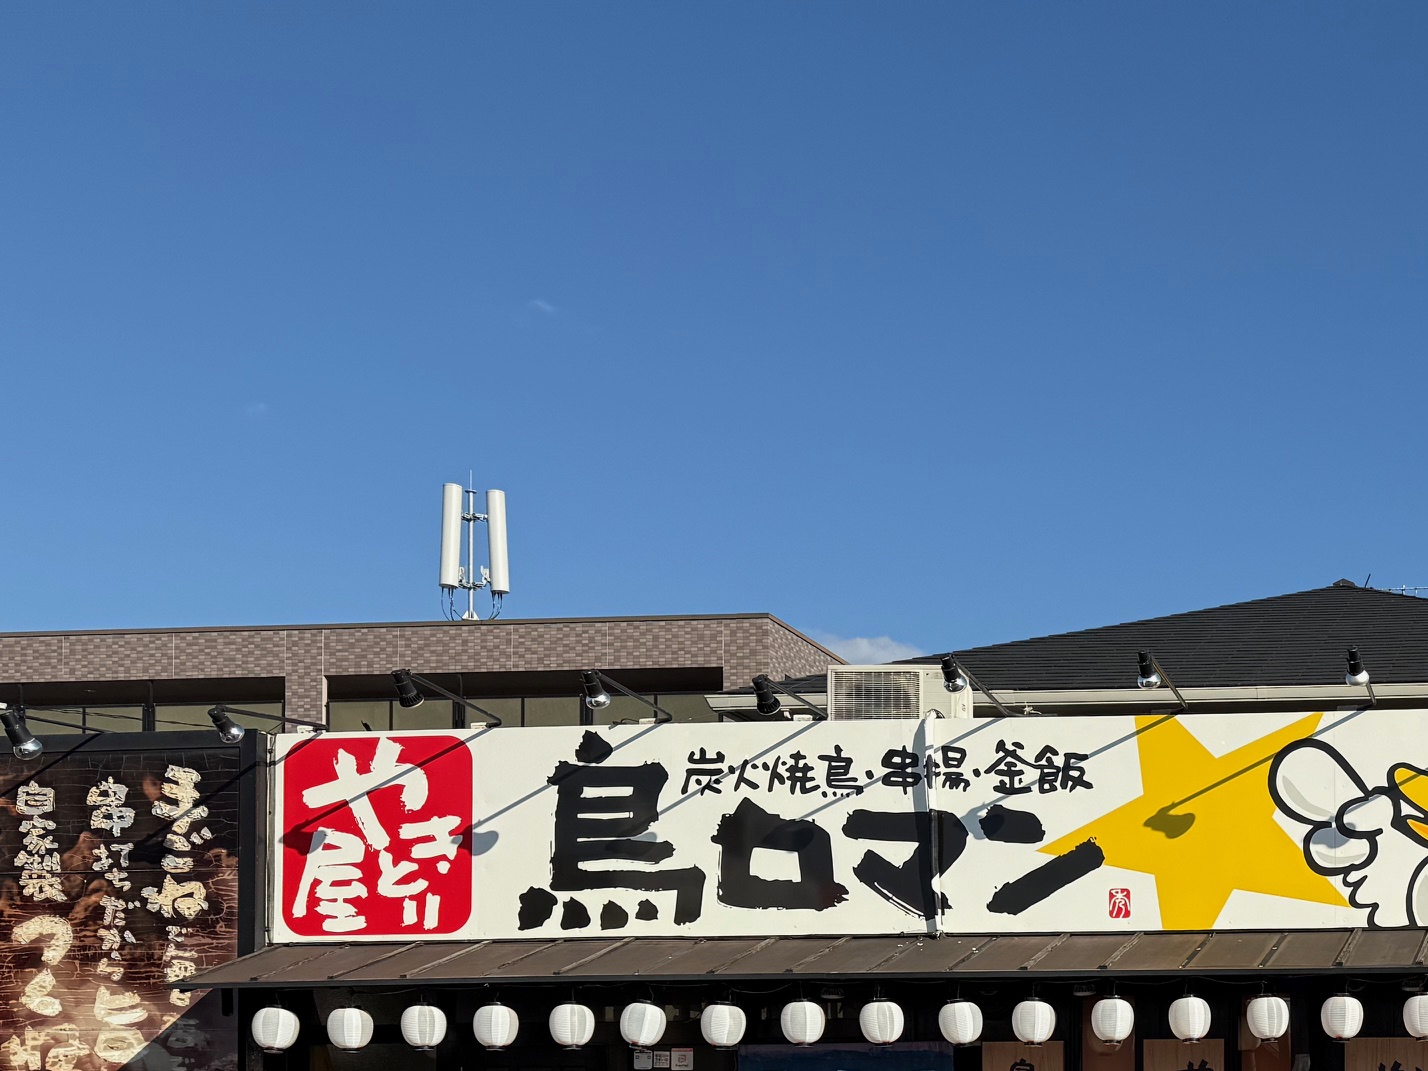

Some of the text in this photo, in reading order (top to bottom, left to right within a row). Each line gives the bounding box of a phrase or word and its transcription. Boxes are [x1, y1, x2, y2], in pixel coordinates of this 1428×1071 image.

[292, 737, 462, 932] やきとり屋
[518, 730, 1106, 930] 鳥ロマン
